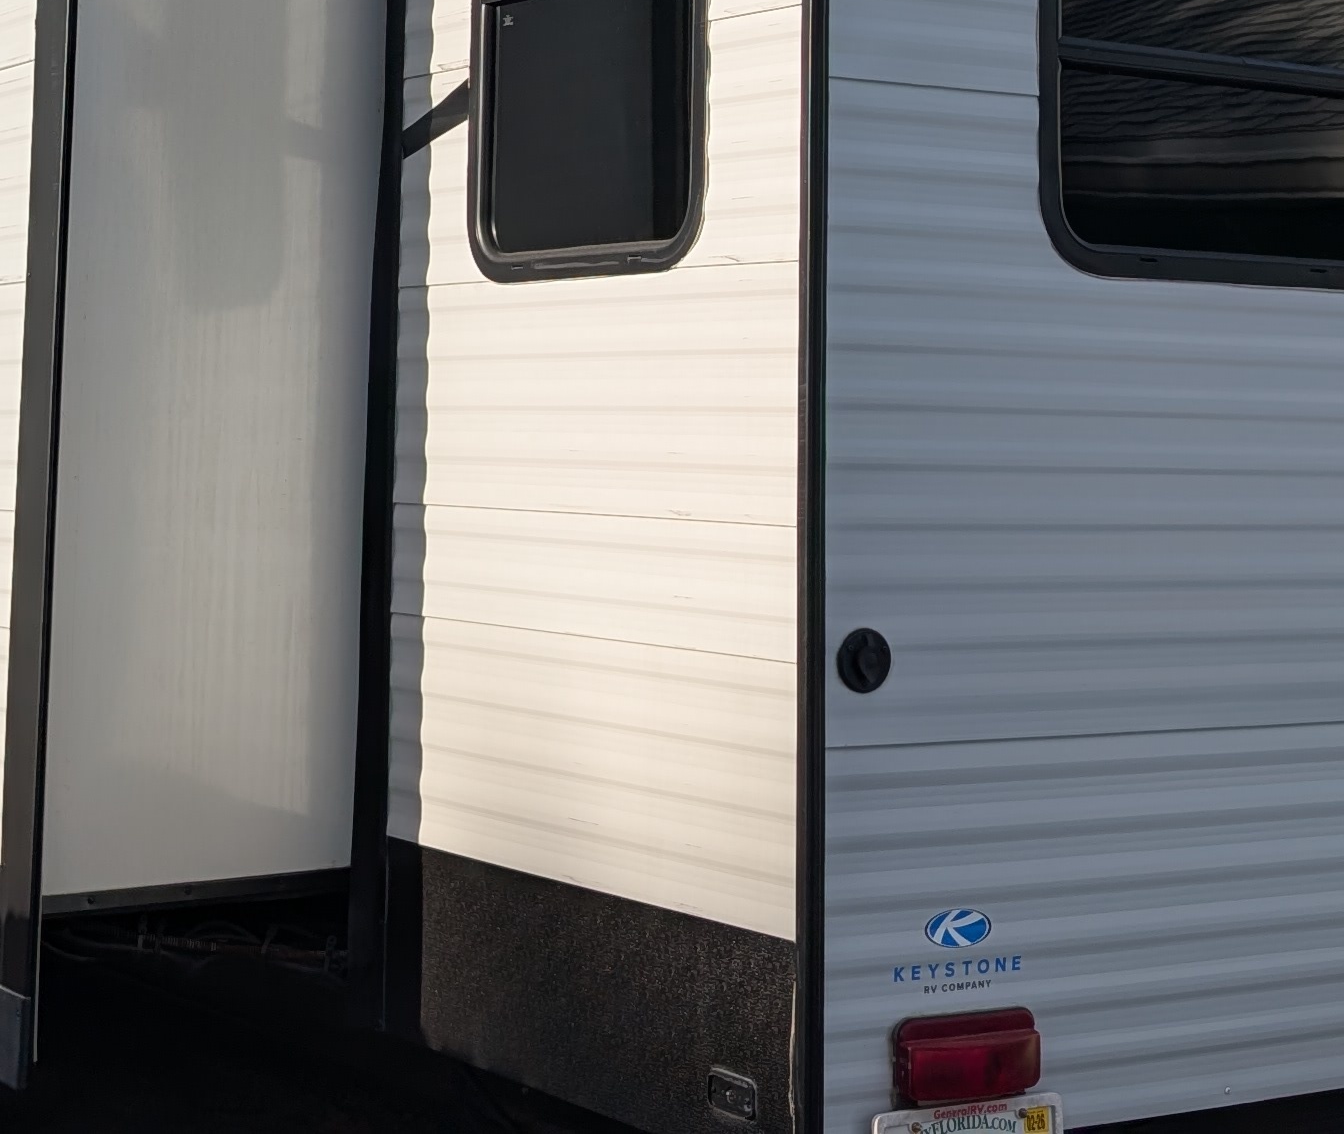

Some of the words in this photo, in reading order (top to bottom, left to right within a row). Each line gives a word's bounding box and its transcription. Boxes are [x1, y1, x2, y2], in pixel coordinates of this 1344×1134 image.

[894, 956, 1021, 982] KEYSTONE
[924, 985, 937, 994] RV
[942, 980, 991, 992] COMPANY
